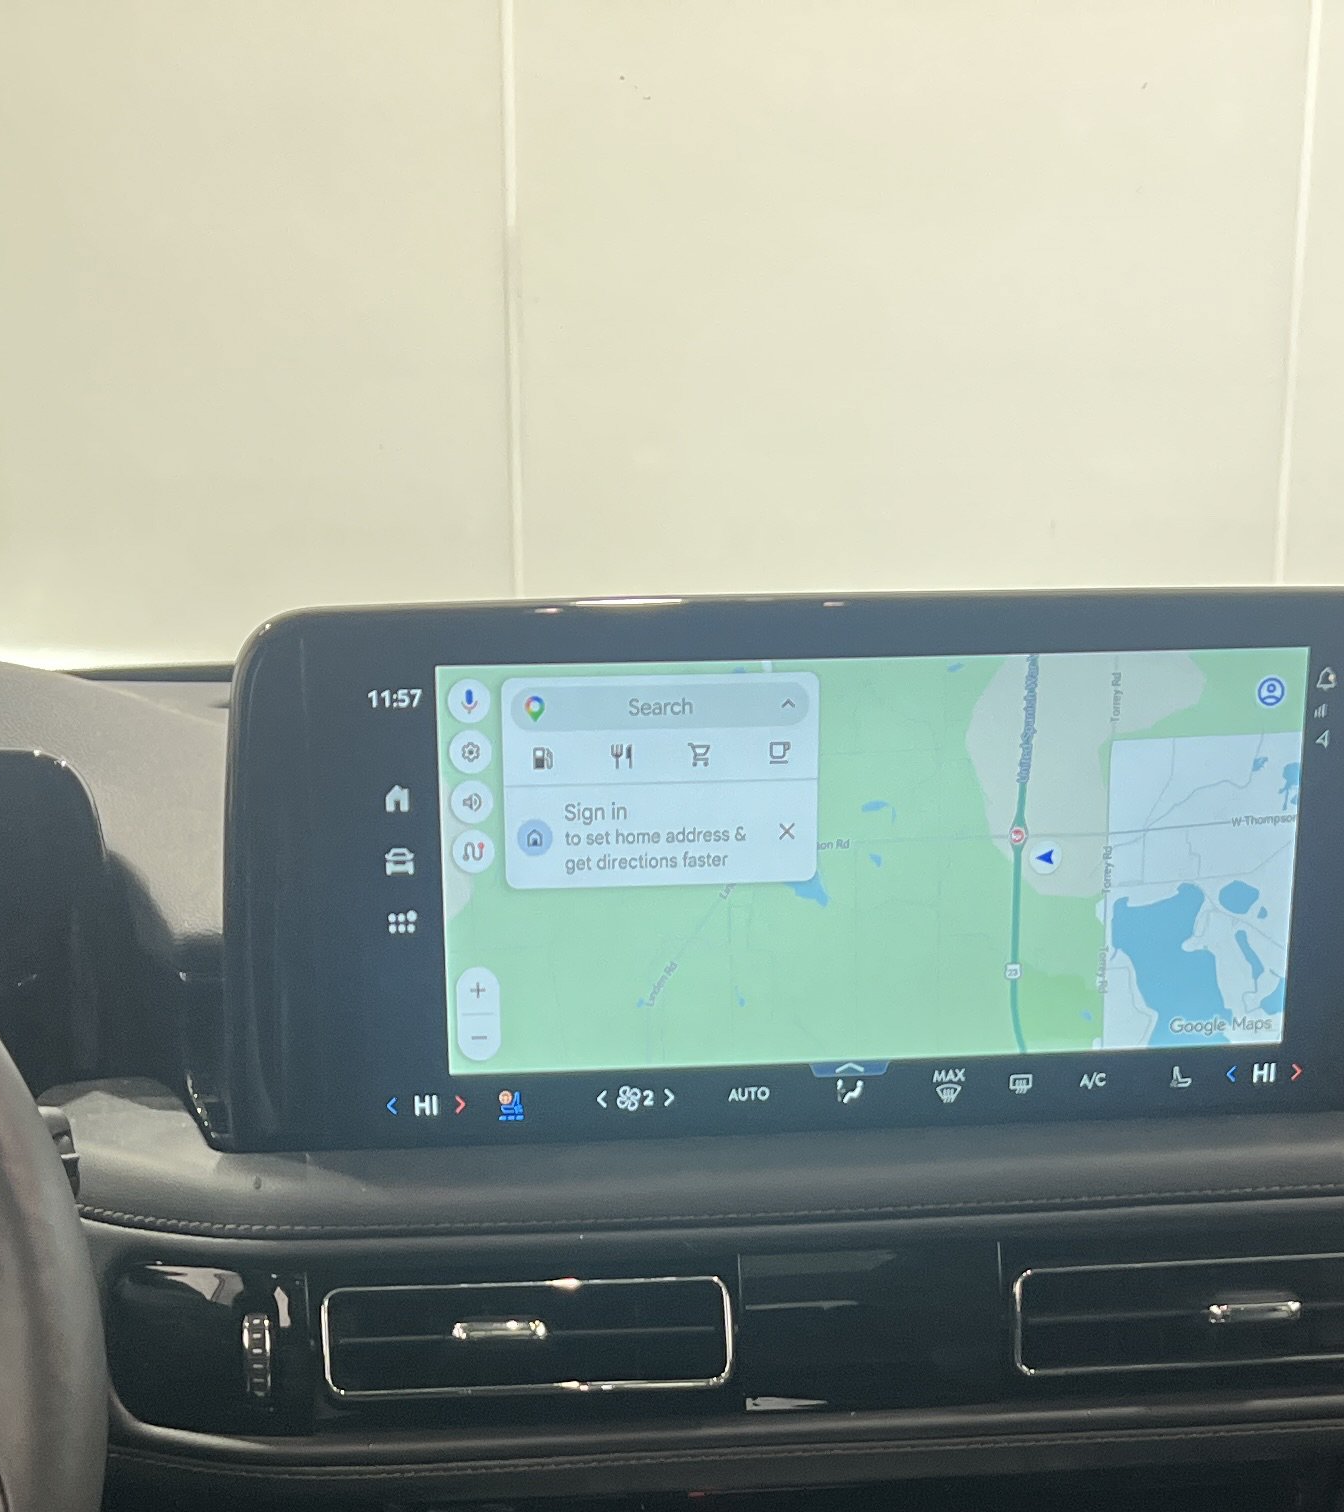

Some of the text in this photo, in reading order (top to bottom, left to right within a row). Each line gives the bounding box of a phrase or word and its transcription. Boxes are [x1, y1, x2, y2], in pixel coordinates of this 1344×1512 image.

[367, 689, 423, 709] 11:57
[628, 697, 694, 717] Search
[564, 802, 628, 825] Sign in
[565, 825, 747, 847] to set home address &
[565, 850, 729, 873] get directions faster
[1169, 1016, 1272, 1036] Google Maps
[932, 1067, 966, 1082] MAX
[1079, 1071, 1107, 1089] A/C
[1252, 1063, 1276, 1084] HI
[643, 1089, 655, 1106] 2
[728, 1085, 770, 1103] AUTO
[413, 1095, 439, 1116] HI
